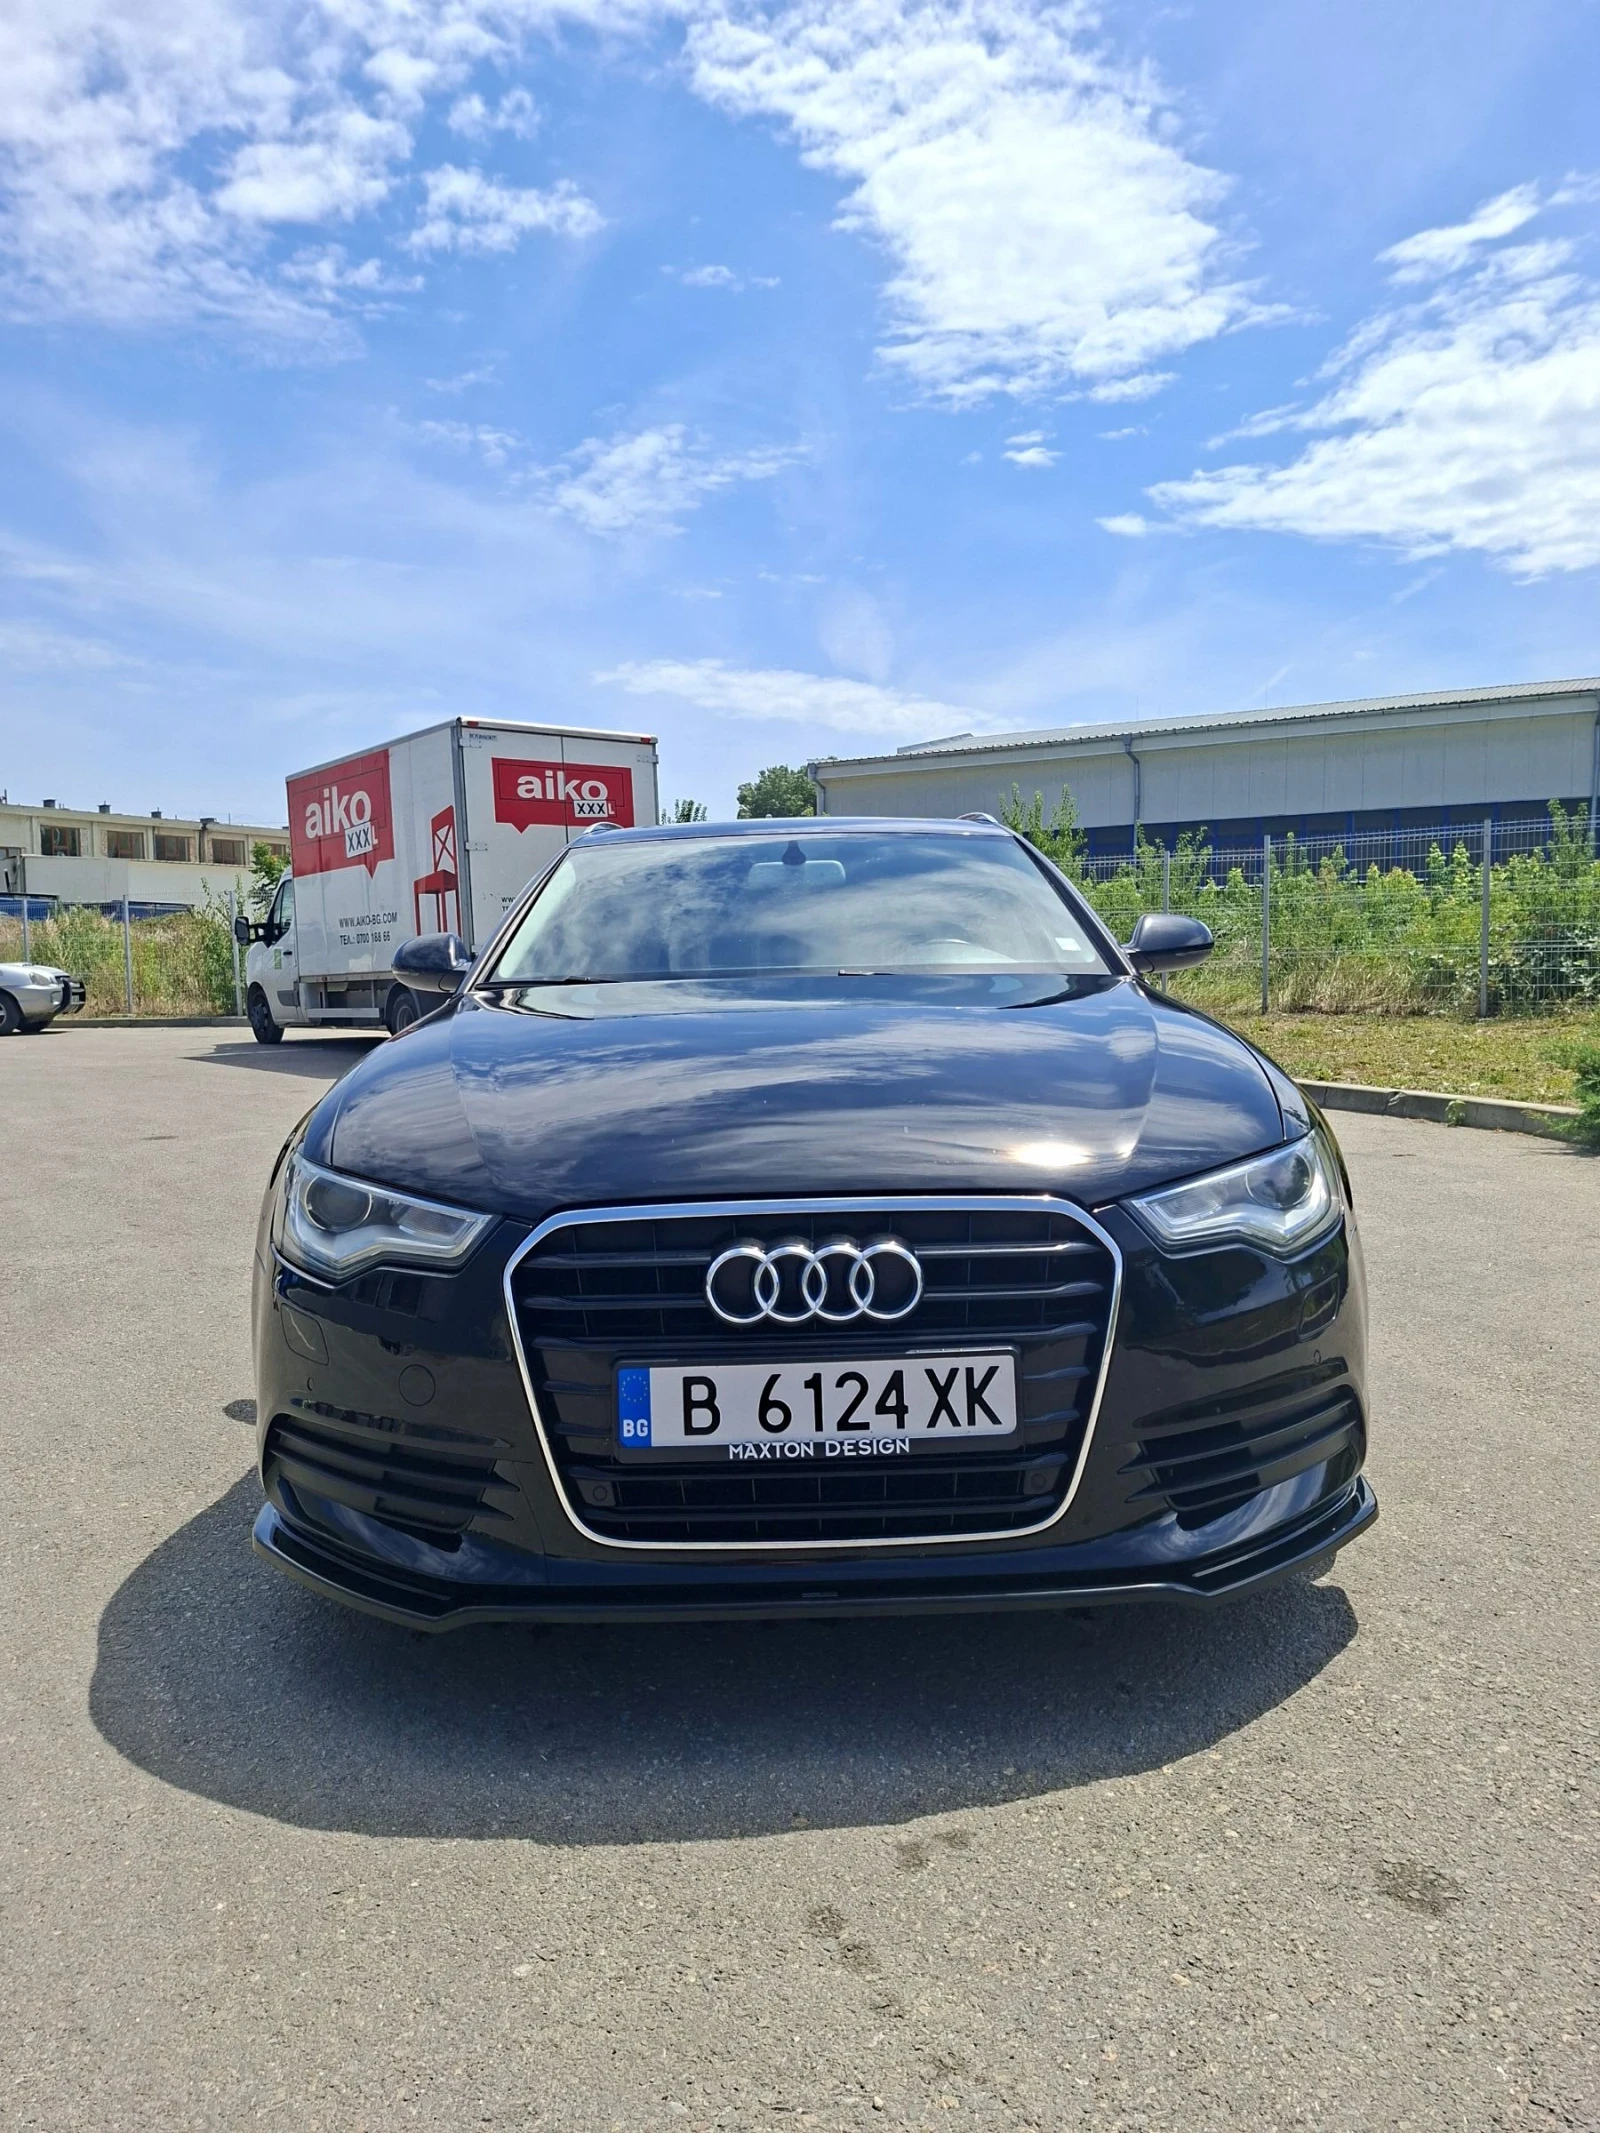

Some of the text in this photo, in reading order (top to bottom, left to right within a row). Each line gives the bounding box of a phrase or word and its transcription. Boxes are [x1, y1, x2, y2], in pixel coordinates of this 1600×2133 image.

[517, 770, 608, 800] aiko
[305, 785, 371, 839] aiko
[339, 911, 398, 928] WWW.AIKO-BG.COM
[356, 932, 370, 944] 0700
[383, 930, 391, 942] 66
[682, 1365, 1003, 1436] B 6124 XK
[622, 1418, 649, 1438] BG
[729, 1437, 910, 1460] MAXTON DESIGN
